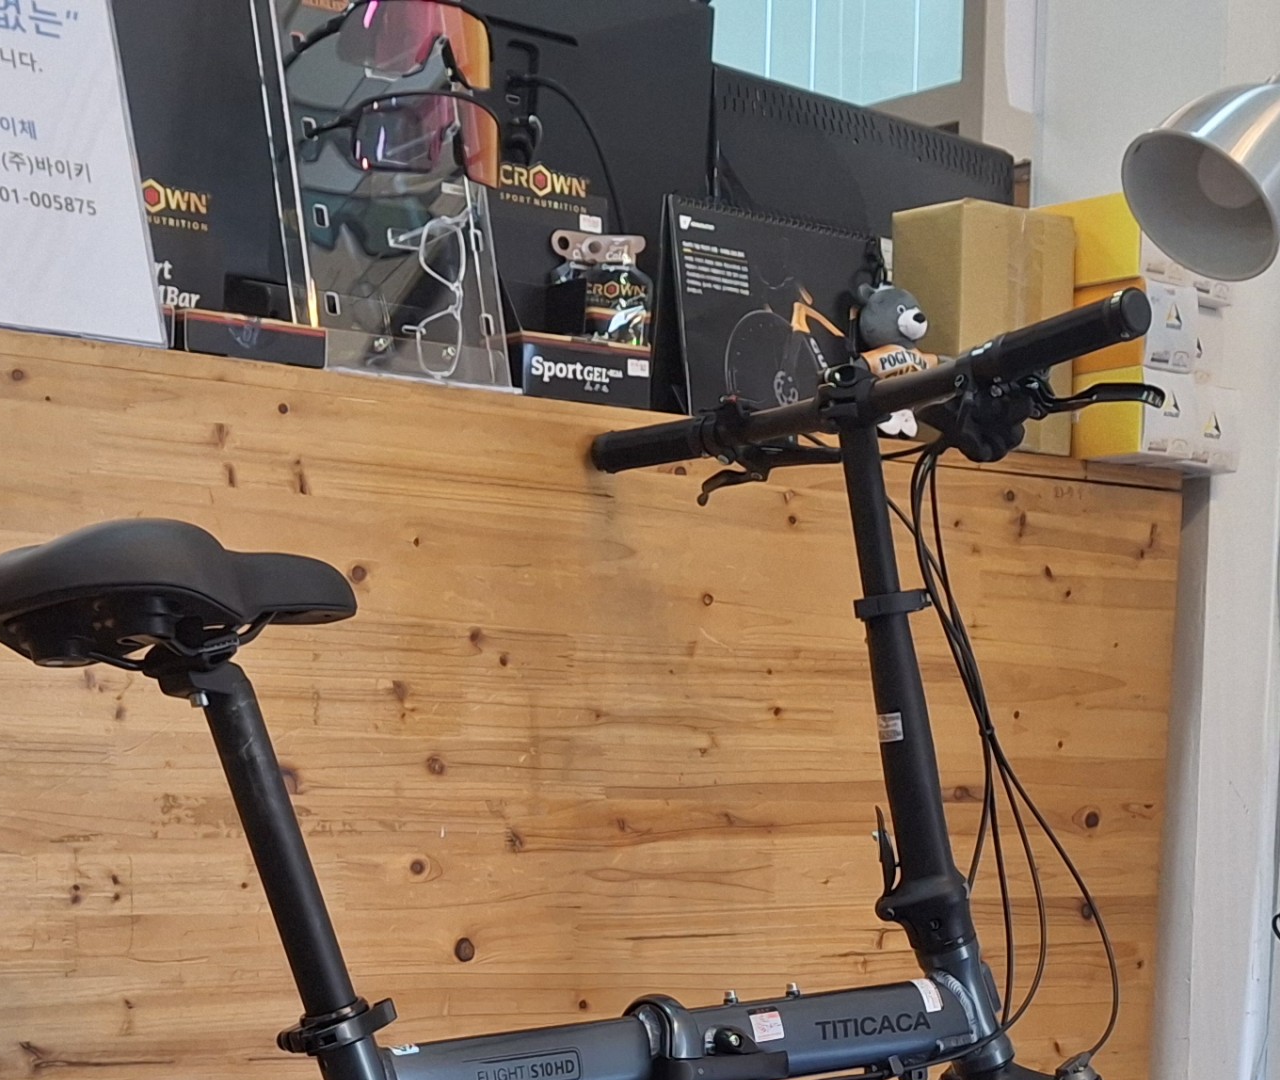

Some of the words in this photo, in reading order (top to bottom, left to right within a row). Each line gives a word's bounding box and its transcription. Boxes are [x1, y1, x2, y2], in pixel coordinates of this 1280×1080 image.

[1, 151, 92, 184] (주)바이키
[500, 164, 587, 199] CROWN
[141, 178, 208, 215] OWN
[500, 192, 530, 205] SPORT
[533, 197, 588, 214] NUTRITION
[879, 351, 907, 371] POGI
[815, 1011, 932, 1041] TITICACA
